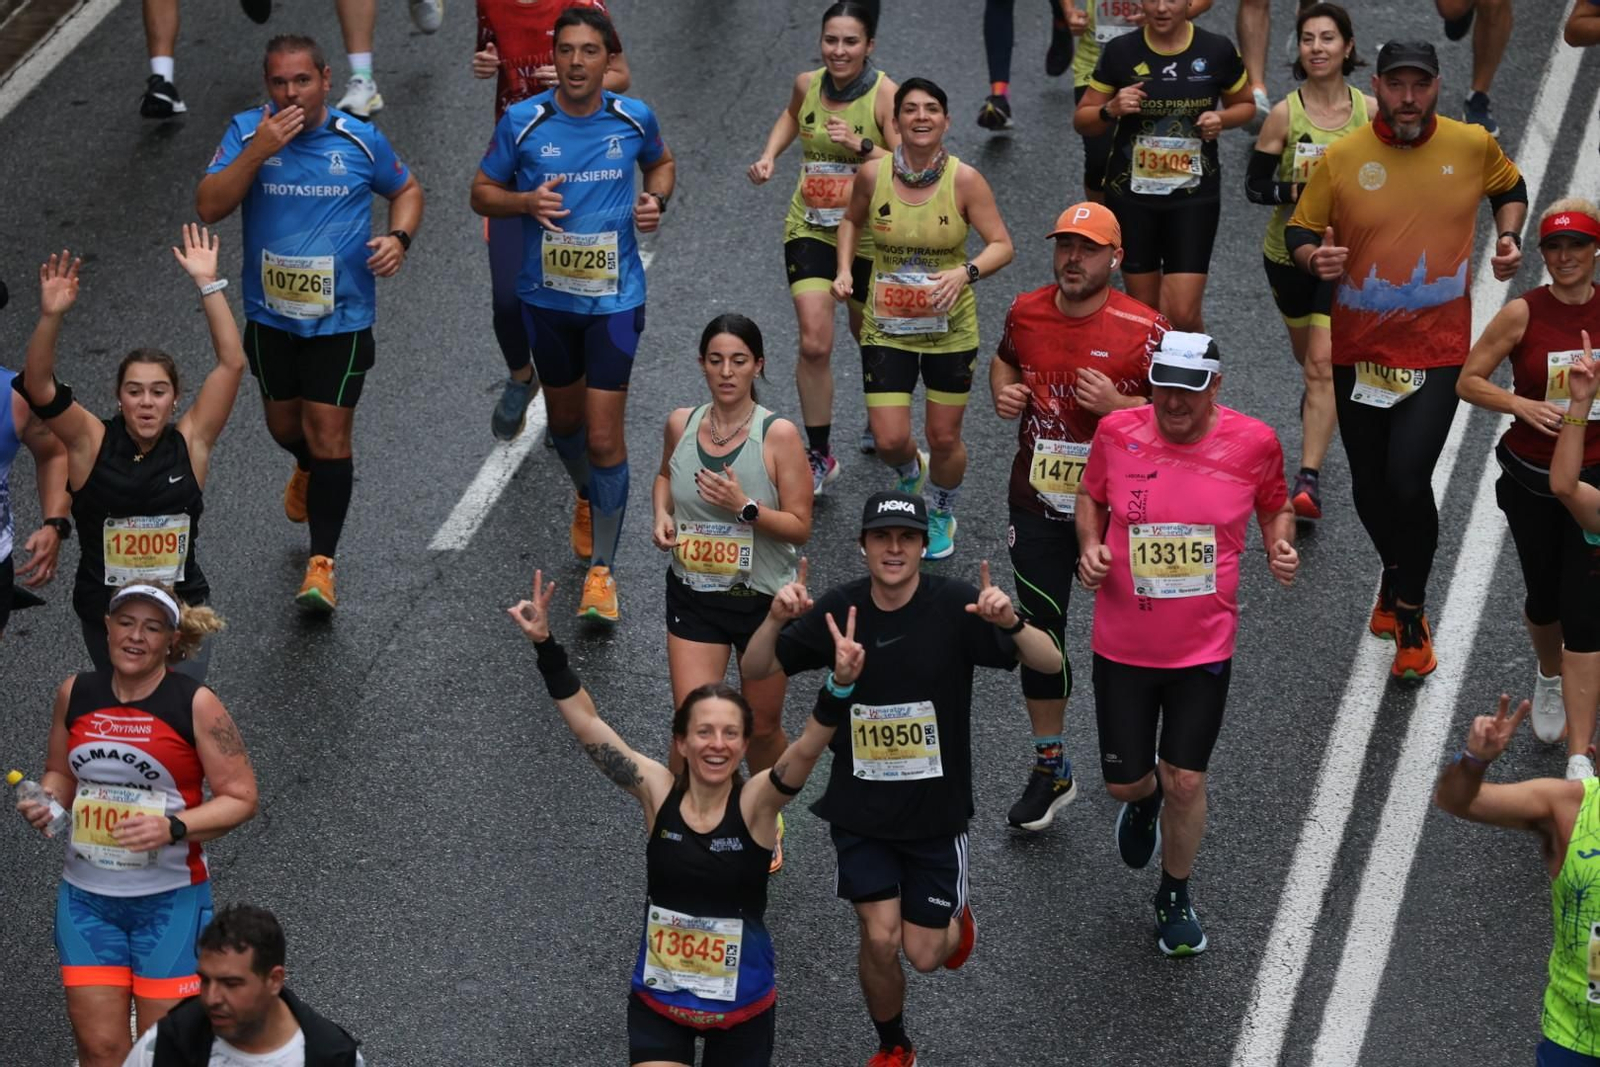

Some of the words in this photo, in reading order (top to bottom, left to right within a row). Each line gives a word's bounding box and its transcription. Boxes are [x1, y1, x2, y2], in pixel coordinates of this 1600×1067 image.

[1141, 99, 1163, 109] GOS
[1138, 150, 1190, 170] 13108
[262, 183, 351, 198] TROTASIERRA
[806, 178, 848, 198] 5327
[1073, 208, 1091, 225] P
[548, 249, 607, 270] 10728
[883, 255, 941, 268] MIRAFLORES
[266, 268, 322, 293] 10726
[884, 287, 927, 309] 5326
[1038, 458, 1087, 483] 1477
[877, 500, 916, 515] HOKA
[111, 532, 177, 555] 12009
[680, 539, 739, 564] 13289
[1137, 541, 1203, 565] 13315
[858, 723, 922, 747] 11950
[72, 748, 160, 781] ALMAGRO
[81, 804, 145, 833] 1101
[927, 896, 952, 908] adidas
[654, 930, 725, 963] 13645
